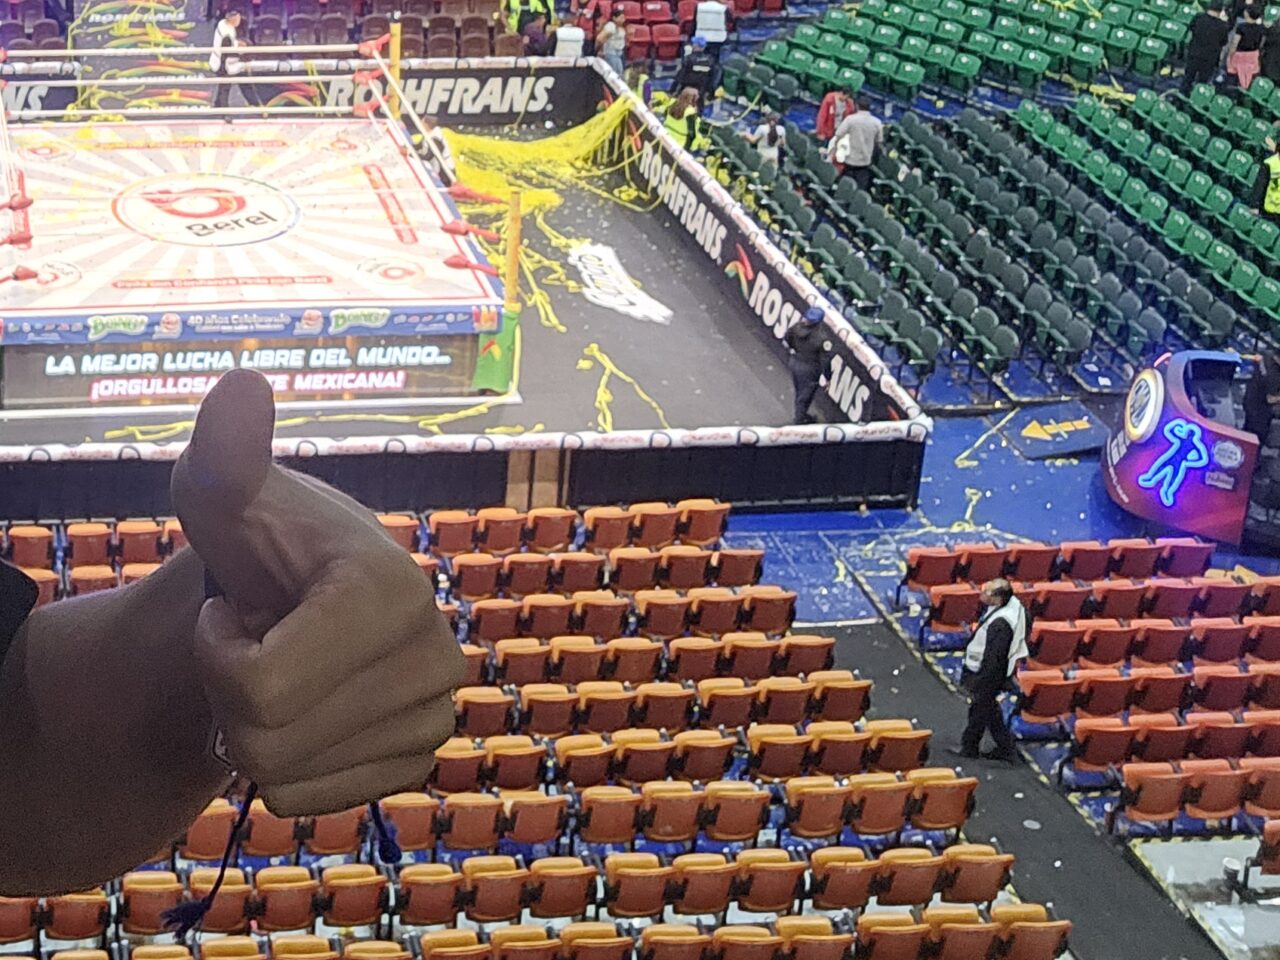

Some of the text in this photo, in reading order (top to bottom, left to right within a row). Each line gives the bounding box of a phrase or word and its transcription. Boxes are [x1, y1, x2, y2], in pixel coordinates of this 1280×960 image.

[325, 76, 556, 115] ROHFRANS
[186, 210, 278, 237] Berel
[45, 355, 76, 375] LA
[81, 352, 159, 374] MEJOR
[163, 350, 235, 372] LUCHA
[240, 348, 305, 368] LIBRE
[309, 347, 352, 367] DEL
[294, 371, 406, 390] MEXICANA!
